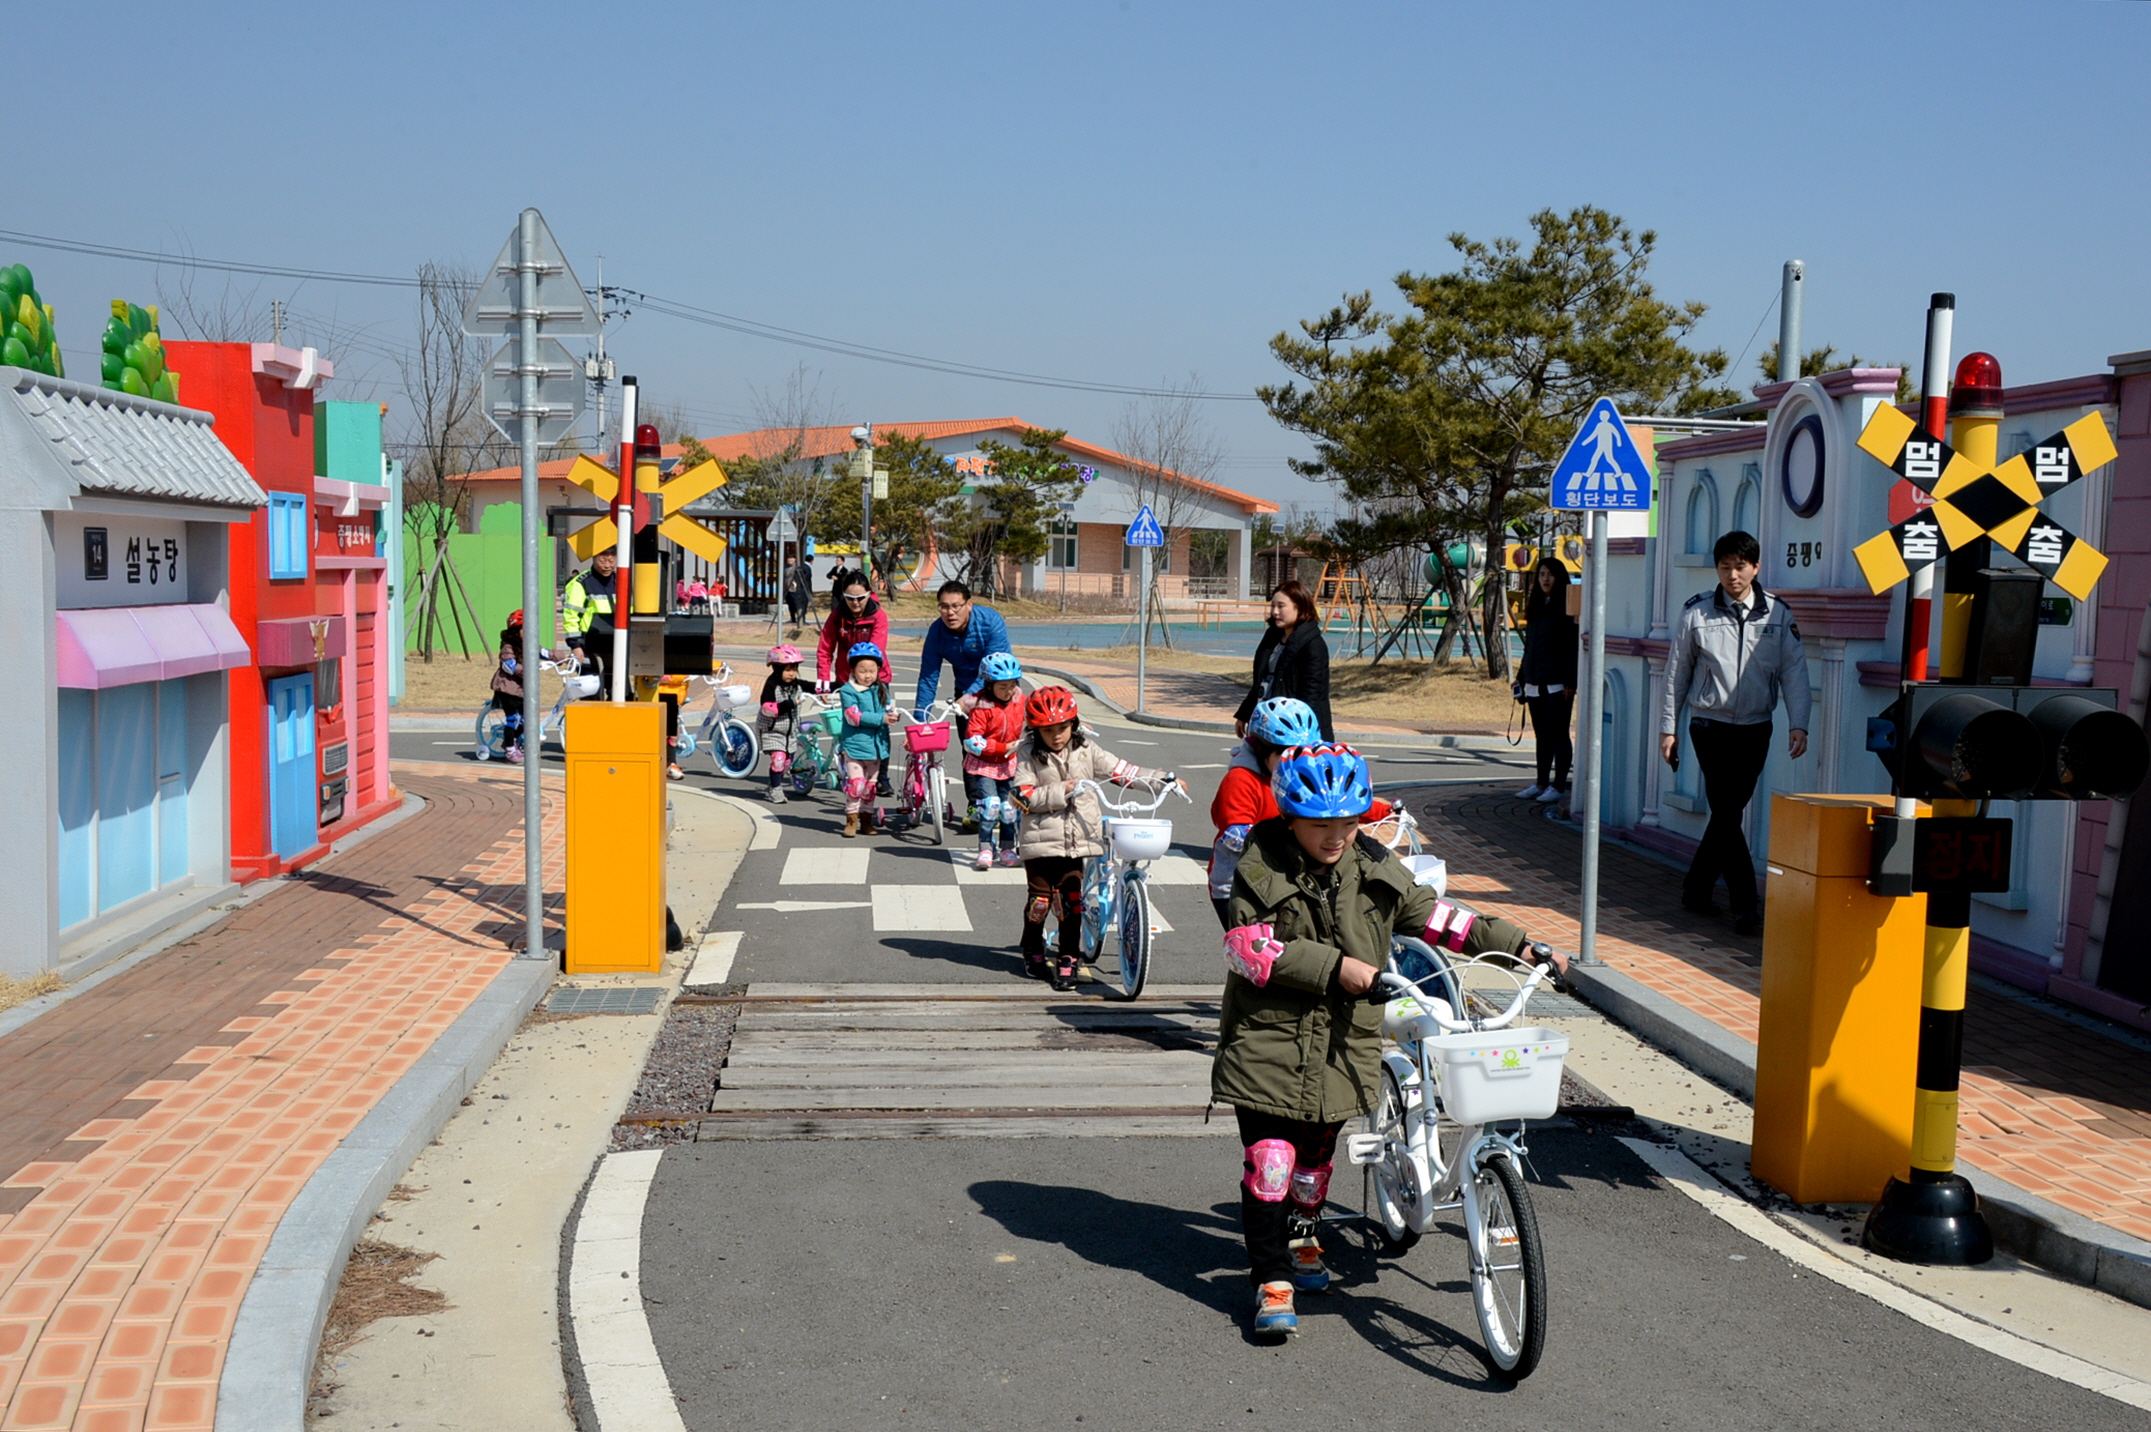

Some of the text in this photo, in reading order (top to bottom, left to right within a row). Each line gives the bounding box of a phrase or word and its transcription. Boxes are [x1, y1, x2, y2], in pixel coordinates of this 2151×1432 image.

[1905, 441, 1940, 478] 멈
[2036, 447, 2069, 482] 멈
[1565, 491, 1638, 507] 횡단보도
[92, 544, 103, 564] 14
[1903, 521, 1938, 559] 춤
[2028, 525, 2063, 564] 춤
[126, 536, 178, 586] 설농탕
[1923, 830, 2002, 881] 정지
